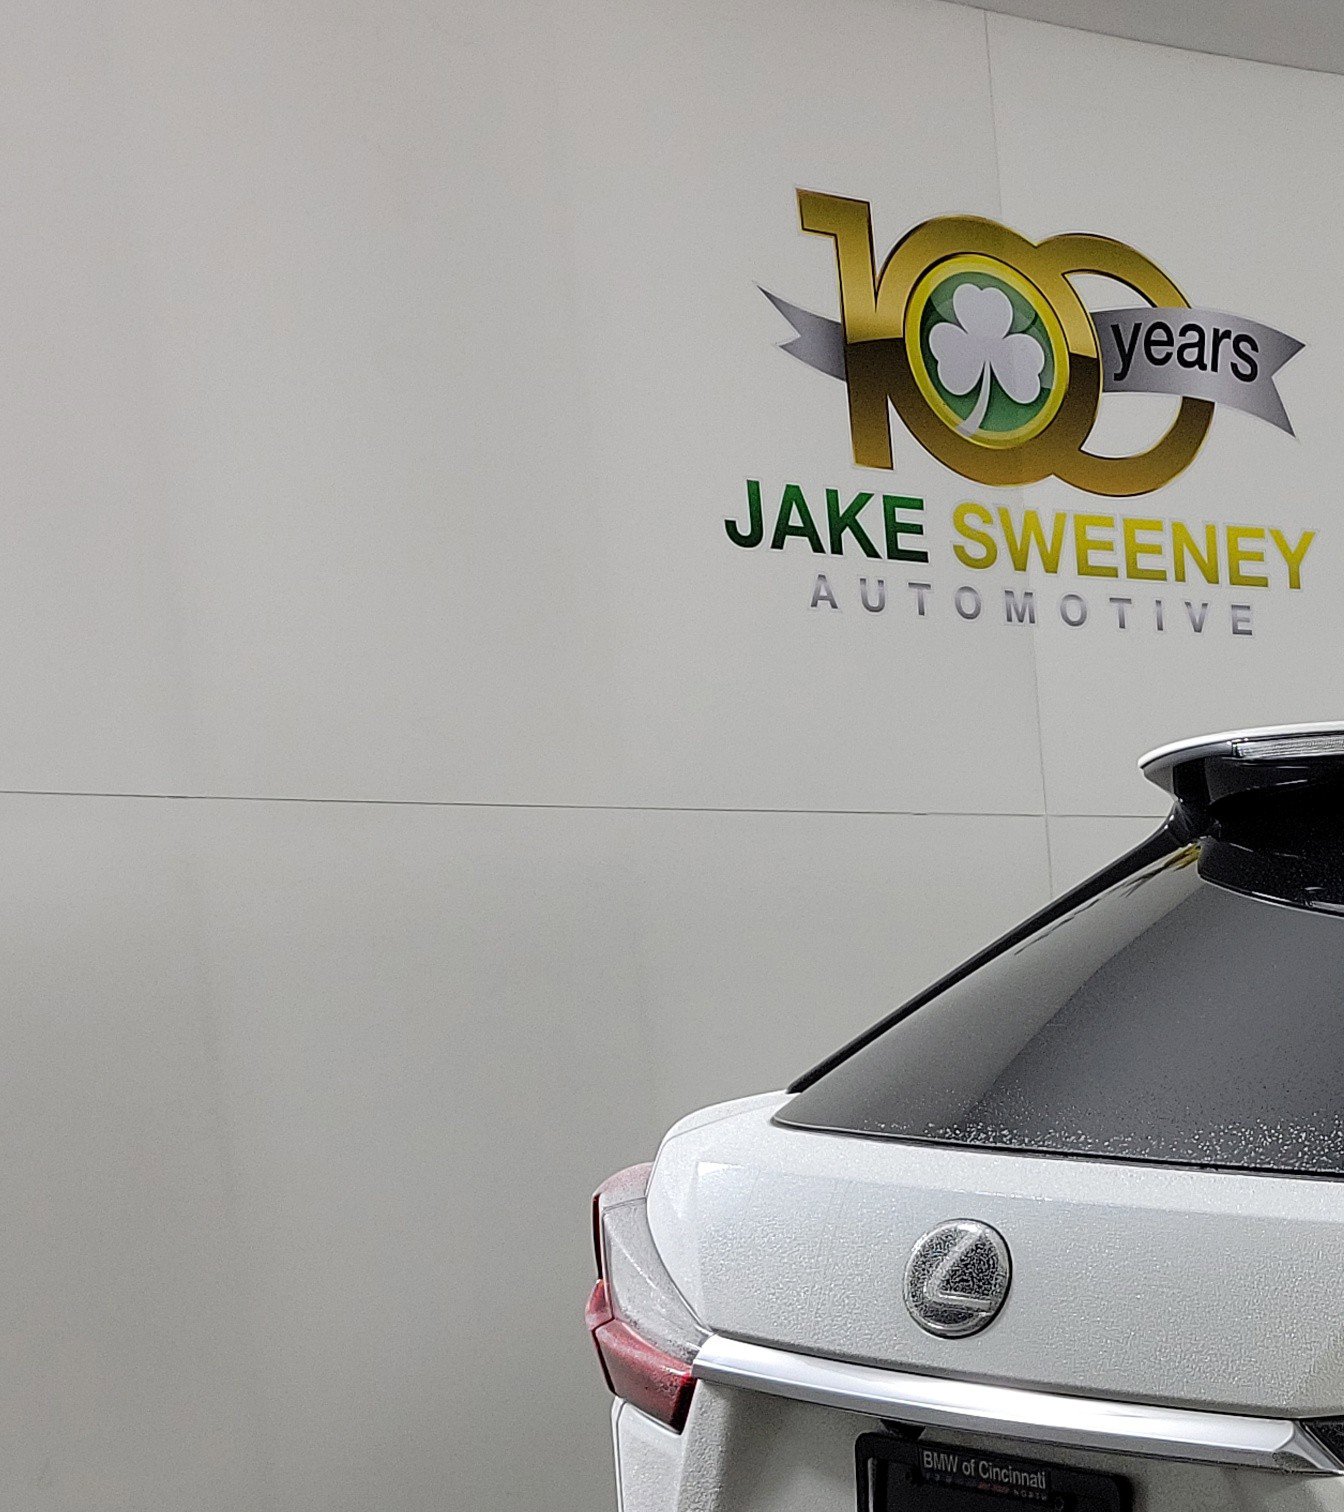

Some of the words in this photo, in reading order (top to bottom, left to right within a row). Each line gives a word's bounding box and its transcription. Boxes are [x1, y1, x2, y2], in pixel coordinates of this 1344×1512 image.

[796, 187, 1215, 497] 100
[1110, 319, 1259, 382] years
[724, 480, 930, 564] JAKE
[951, 502, 1317, 590] SWEENEY
[810, 574, 1254, 636] AUTOMOTIVE
[922, 1450, 959, 1474] BMW
[962, 1459, 976, 1476] of
[978, 1459, 1047, 1490] Cincinnati
